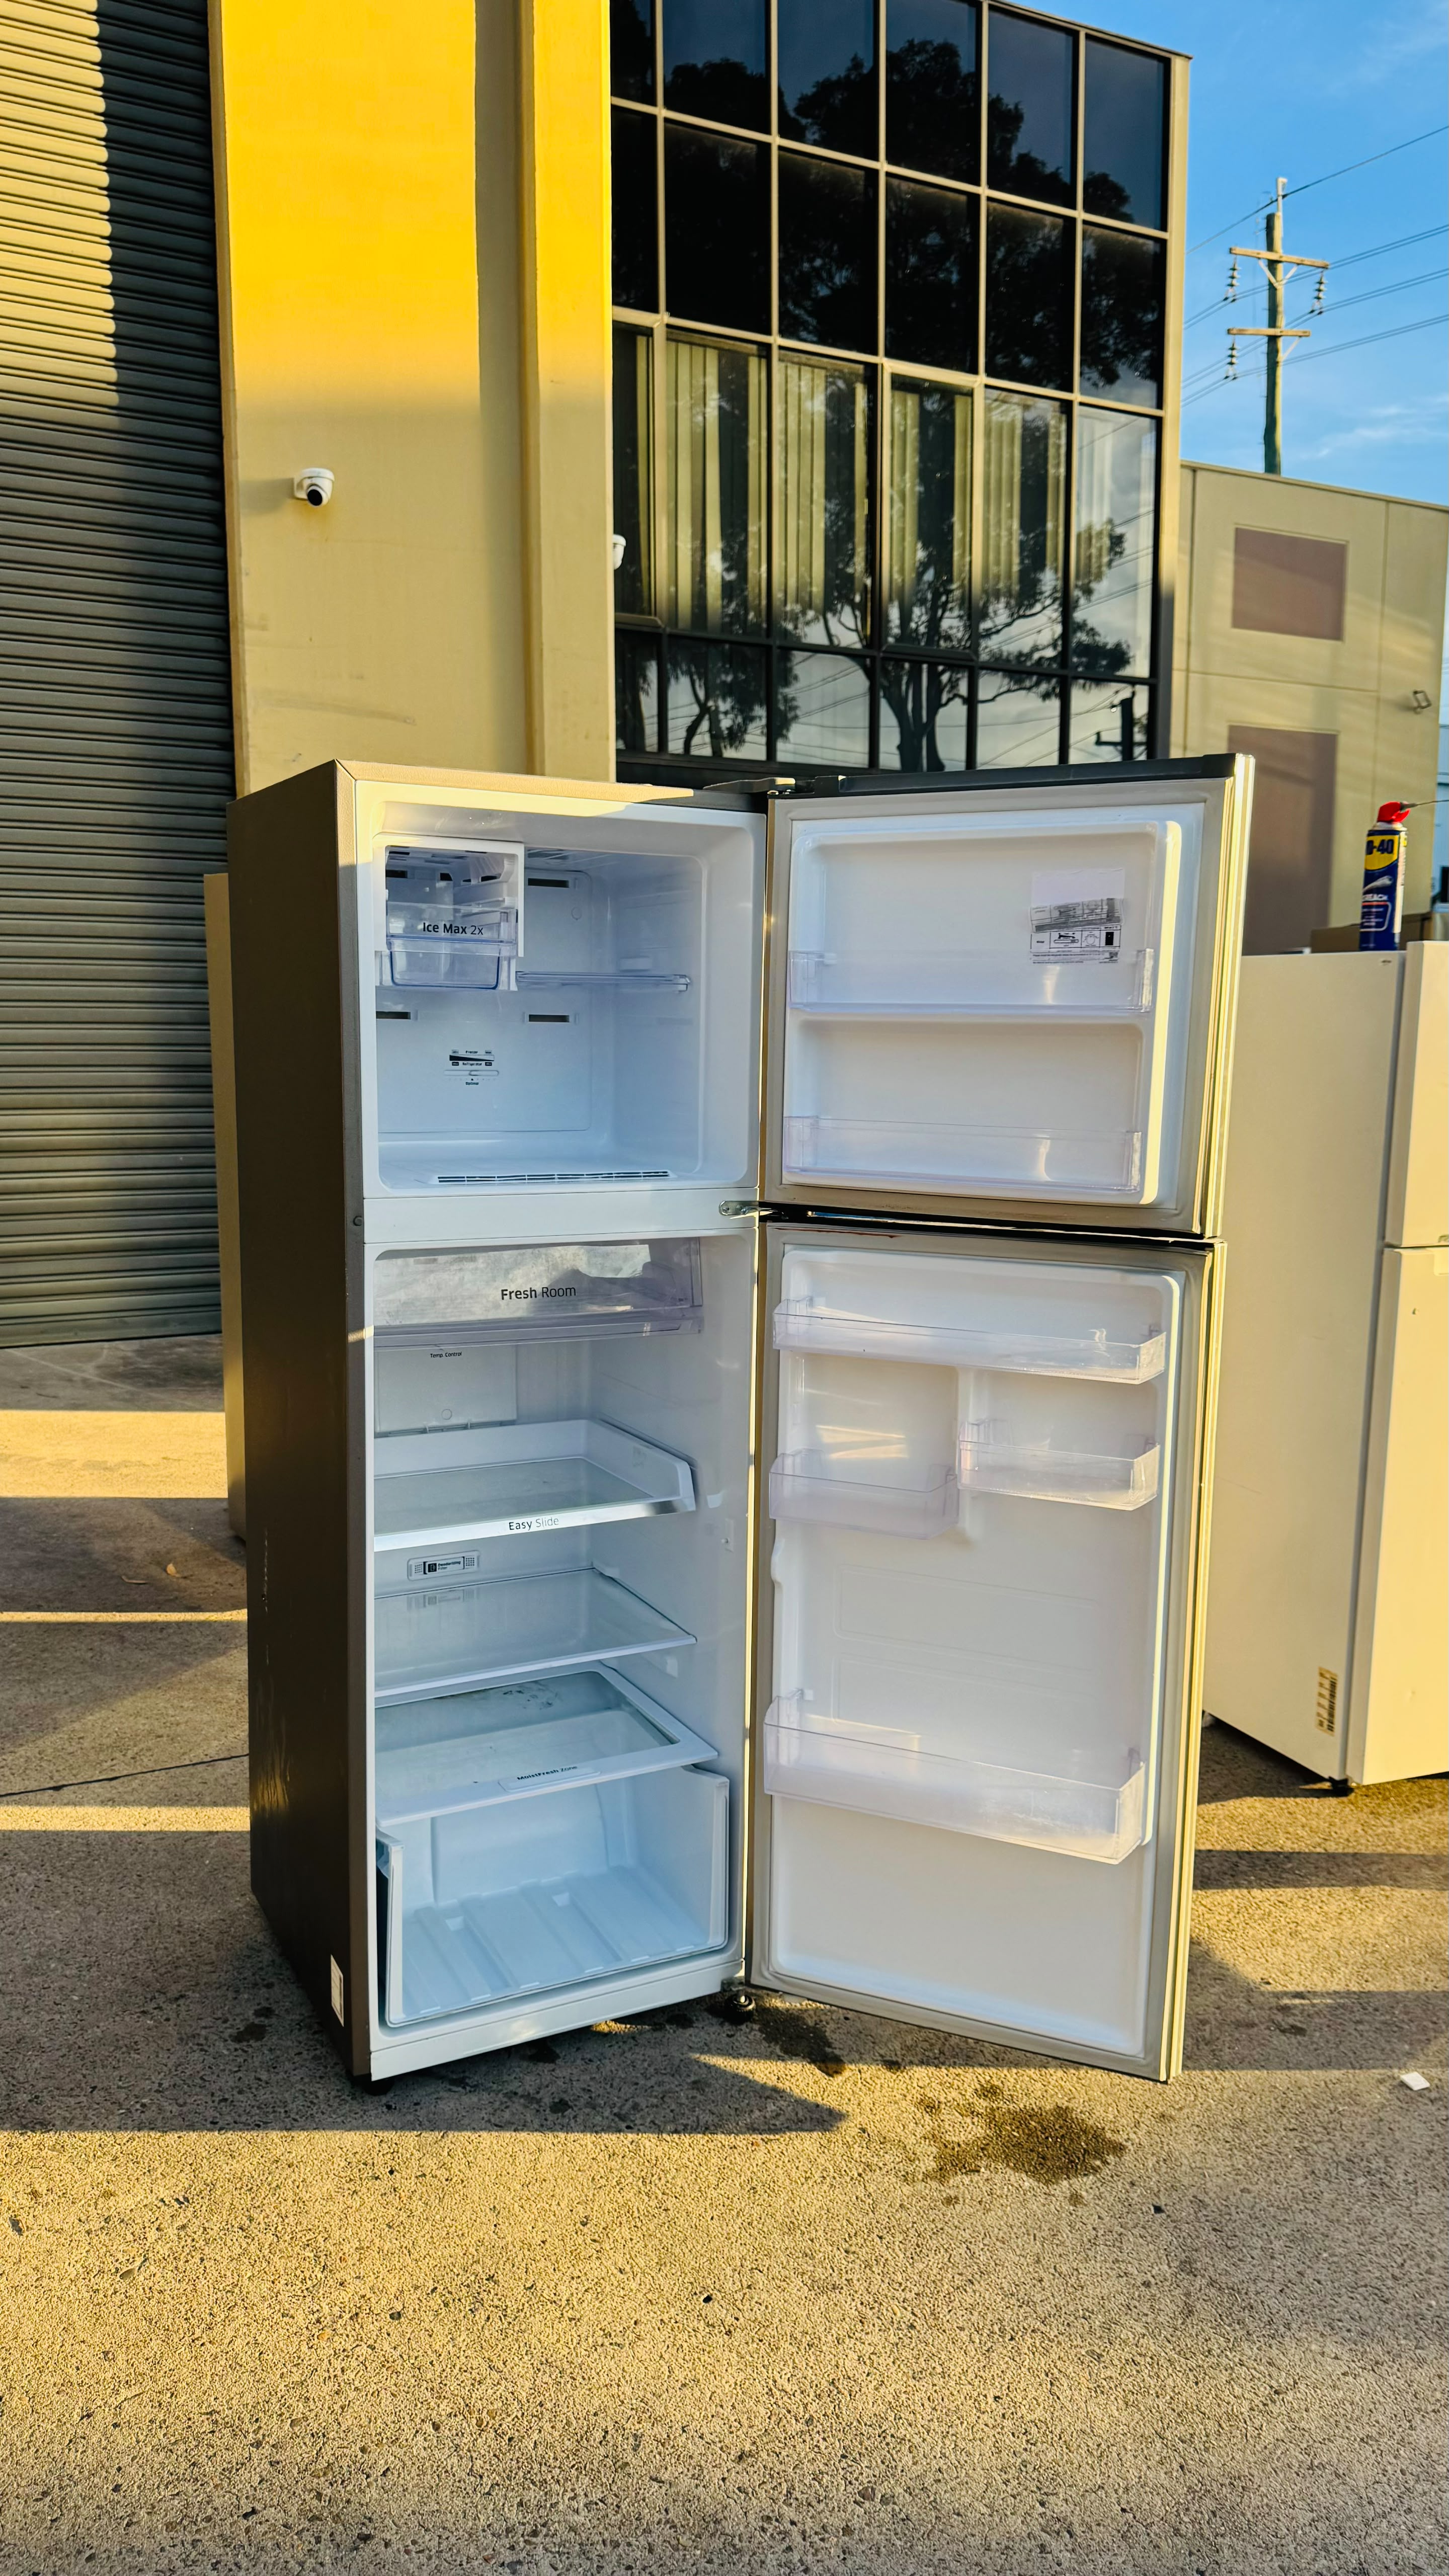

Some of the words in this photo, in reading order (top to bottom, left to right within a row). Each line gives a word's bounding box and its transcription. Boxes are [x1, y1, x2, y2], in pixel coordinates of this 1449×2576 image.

[1366, 839, 1394, 855] D-40
[423, 922, 439, 932] Ice
[443, 923, 467, 934] Max
[470, 925, 483, 935] 2x
[501, 1287, 537, 1300] Fresh
[542, 1287, 576, 1298] Room
[509, 1521, 532, 1531] Easy
[535, 1517, 559, 1527] Slide
